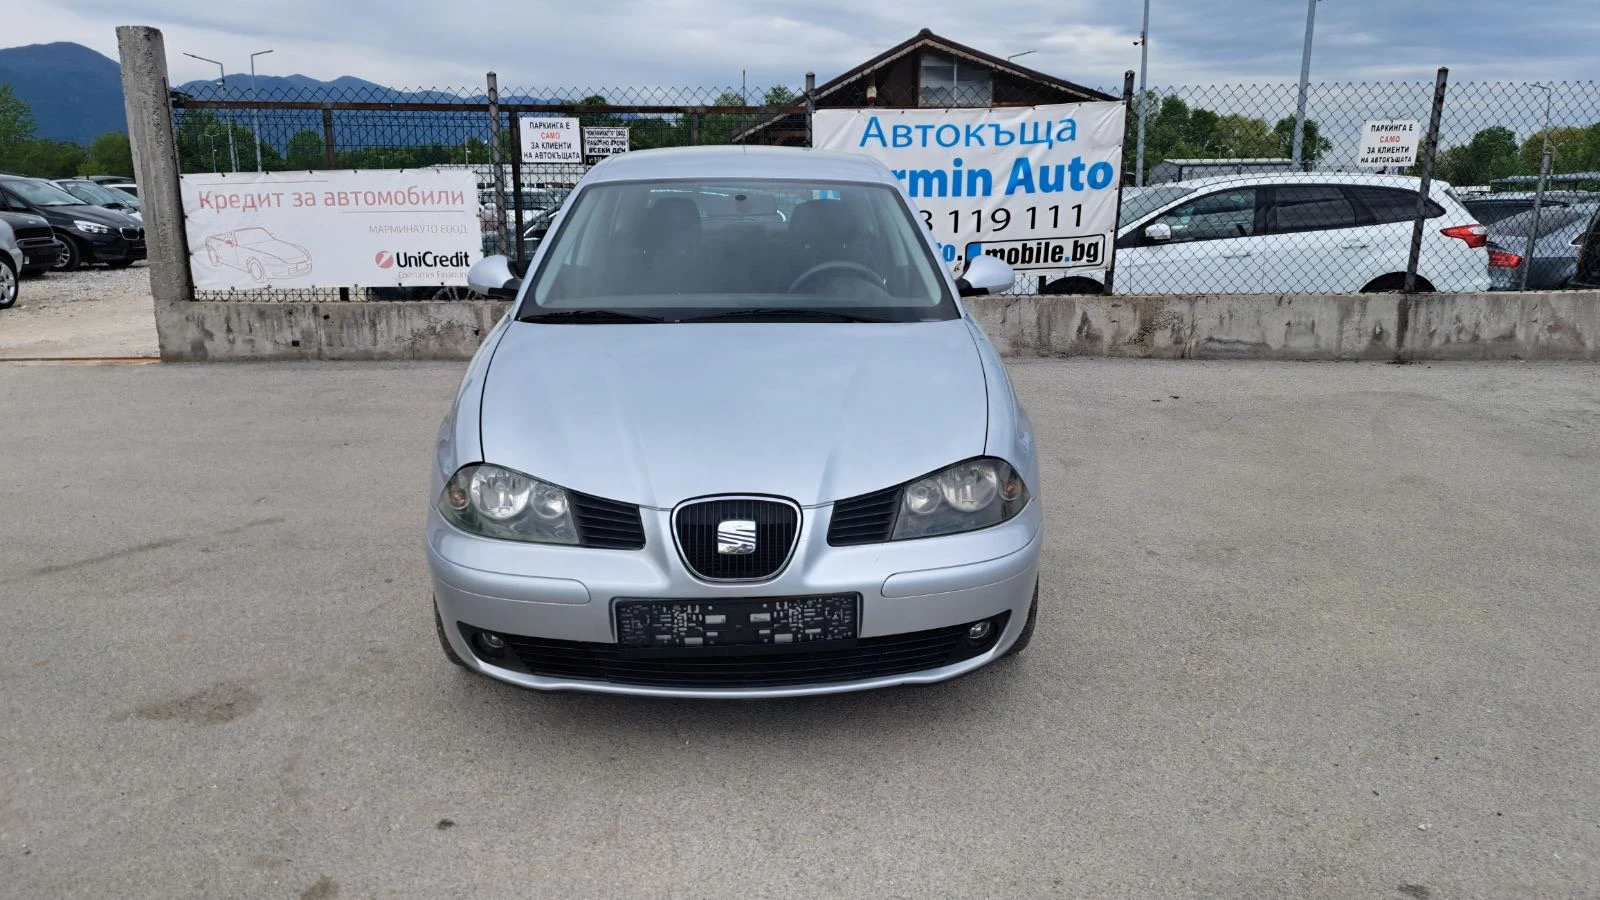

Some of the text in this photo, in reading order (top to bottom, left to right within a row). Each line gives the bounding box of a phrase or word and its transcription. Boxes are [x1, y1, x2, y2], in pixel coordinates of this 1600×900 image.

[529, 121, 564, 130] ПАРКИНГА
[1371, 124, 1407, 132] ПАРКИНГА
[540, 132, 561, 140] САМО
[859, 115, 1078, 150] Автокъща
[1379, 135, 1401, 143] САМО
[530, 142, 572, 150] ЗА КЛИЕНТИ
[1377, 146, 1410, 154] КЛИЕНТИ
[523, 152, 533, 160] НА
[534, 151, 581, 161] АВТОКЪЩАТА
[1370, 156, 1412, 164] АВТОКЪЩАТА
[1005, 156, 1114, 196] Auto
[198, 184, 465, 215] Кредит за автомобили
[948, 207, 1011, 233] 119
[1026, 203, 1083, 230] 111
[368, 224, 467, 234] МАРМИНАУТО ЕООД
[396, 250, 470, 268] UniCredit
